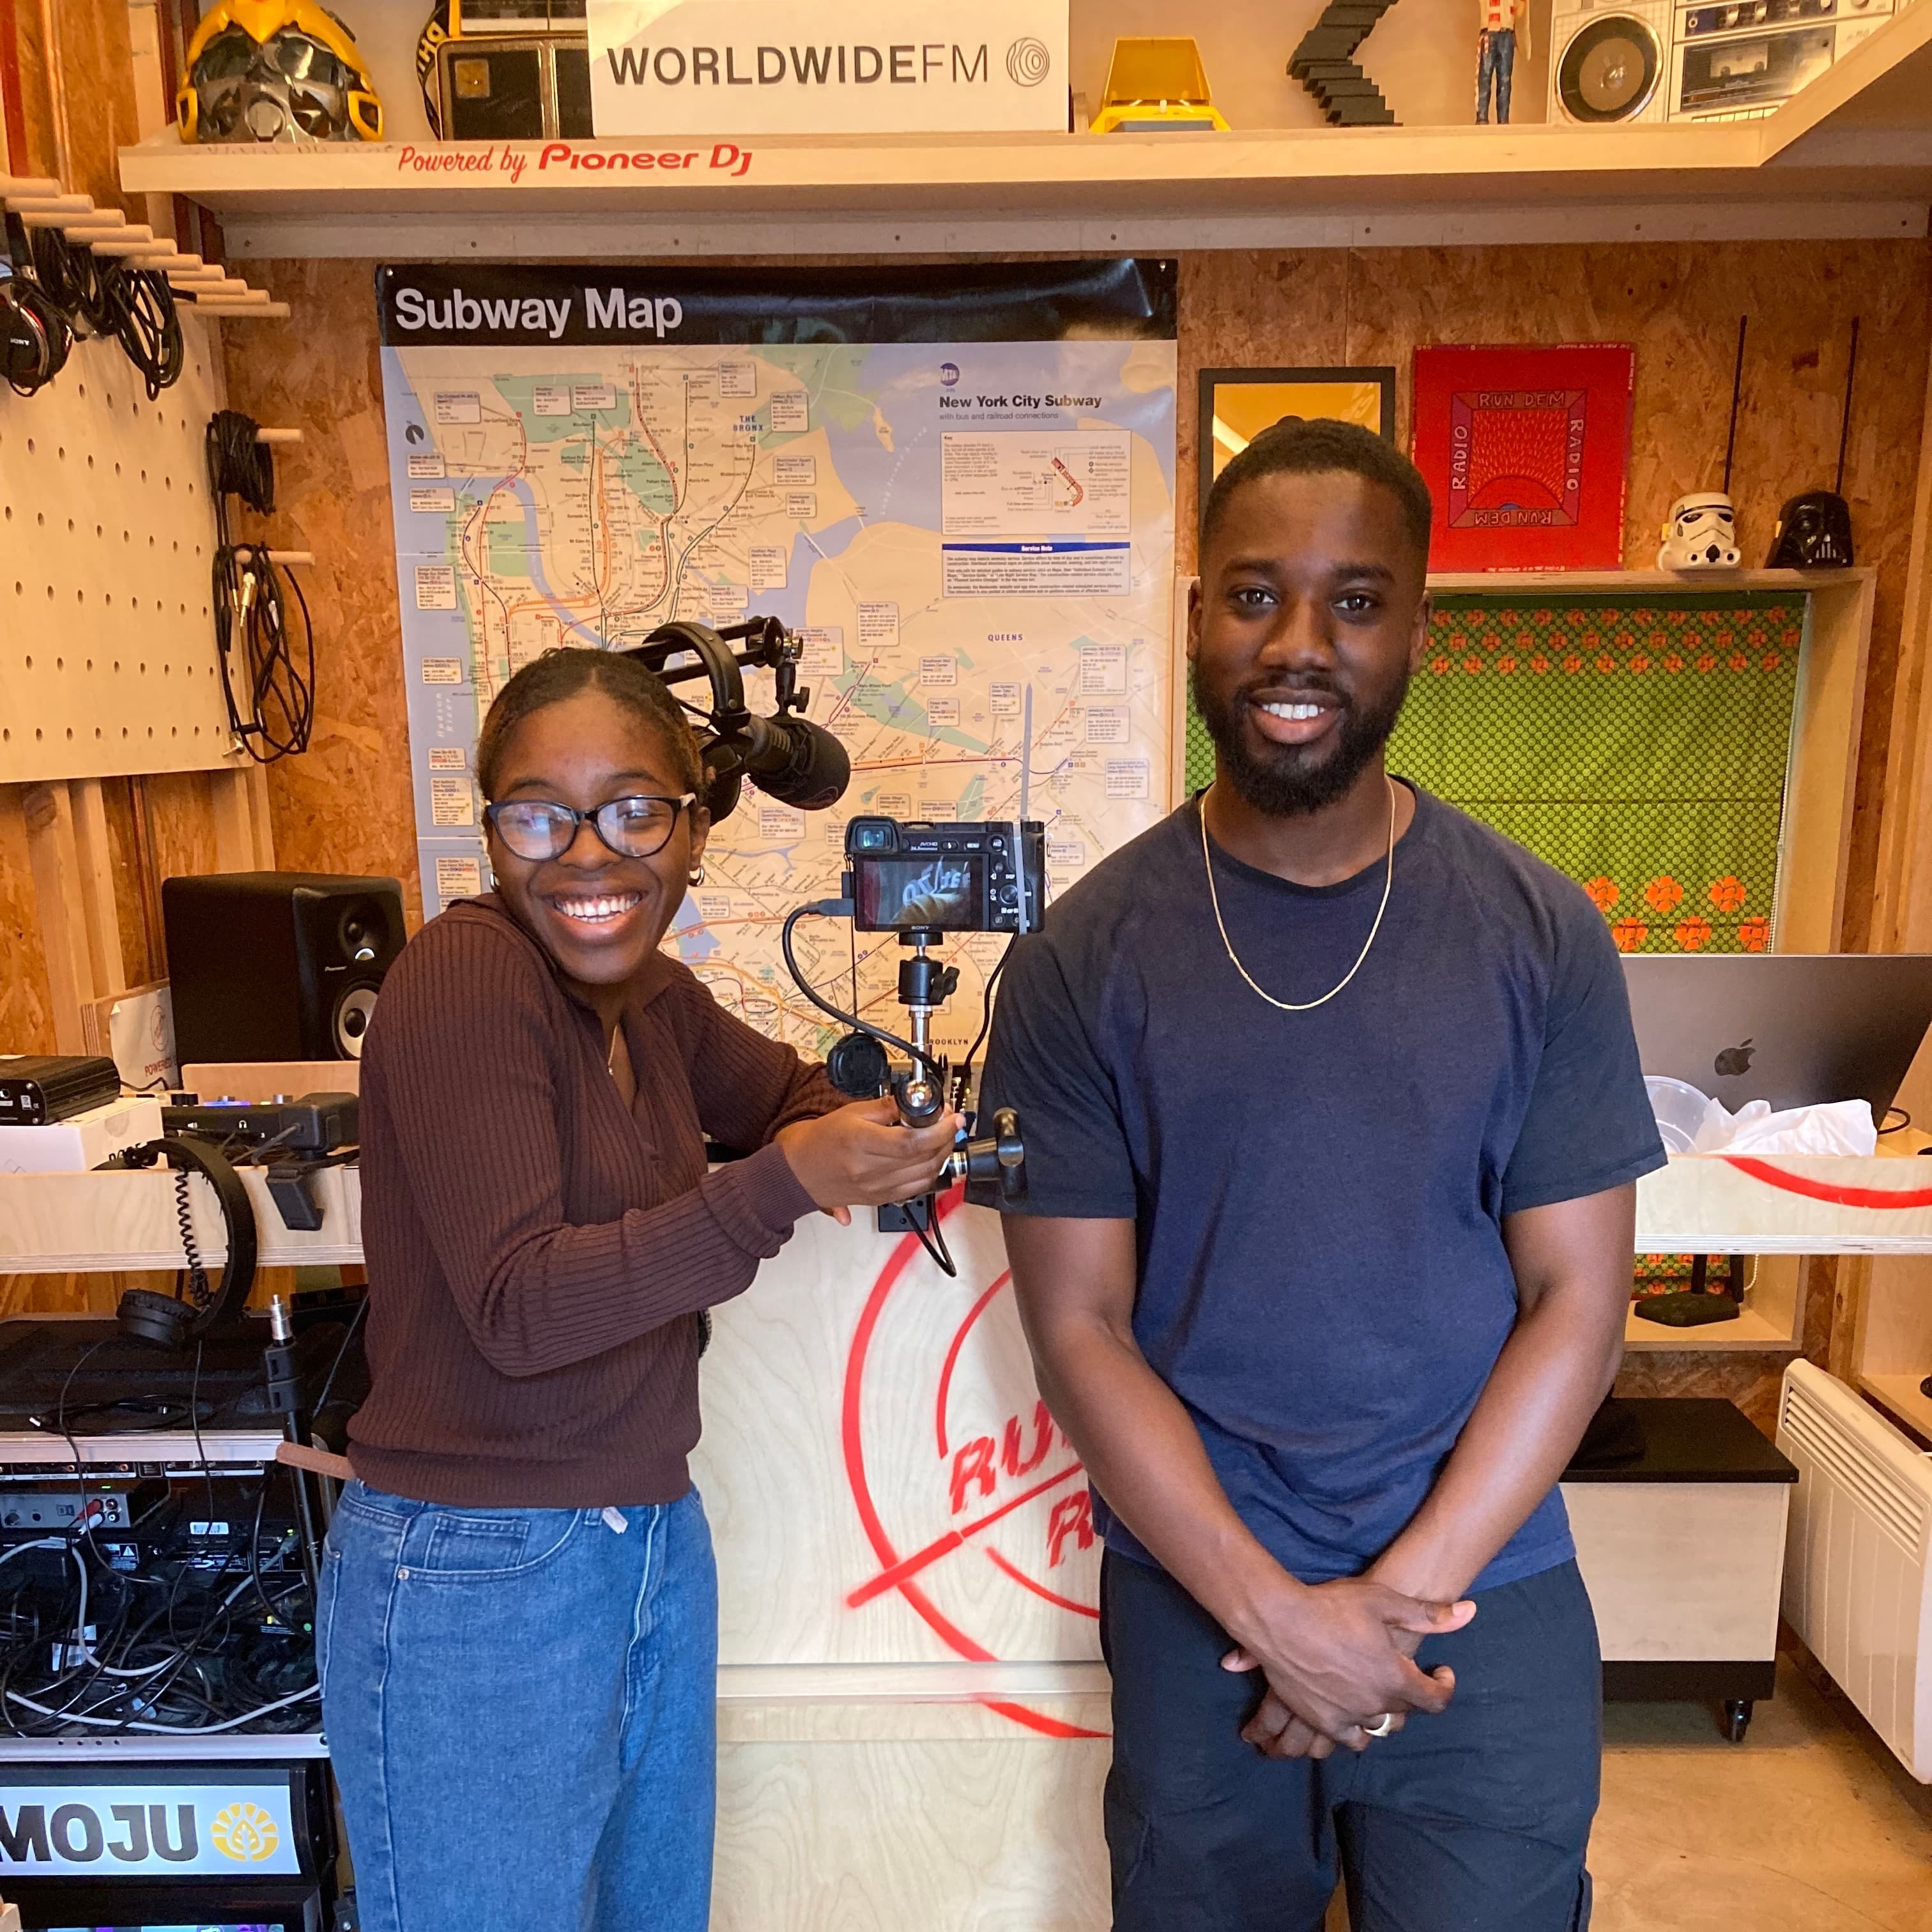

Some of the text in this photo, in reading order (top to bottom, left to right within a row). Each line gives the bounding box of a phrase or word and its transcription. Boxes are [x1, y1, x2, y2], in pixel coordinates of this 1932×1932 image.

[608, 44, 988, 86] WORLDWIDEFM
[399, 145, 493, 172] Powered
[500, 145, 527, 184] by
[539, 144, 699, 170] Pioneer
[395, 288, 682, 339] Subway Map
[940, 395, 1103, 408] New York City Subway
[1479, 393, 1565, 407] RUN DEM
[1452, 425, 1468, 490] RADIO
[1567, 419, 1584, 491] RADIO
[1475, 512, 1552, 525] RUN DEM
[949, 1398, 1071, 1516] RU
[0, 1803, 199, 1862] MOJU
